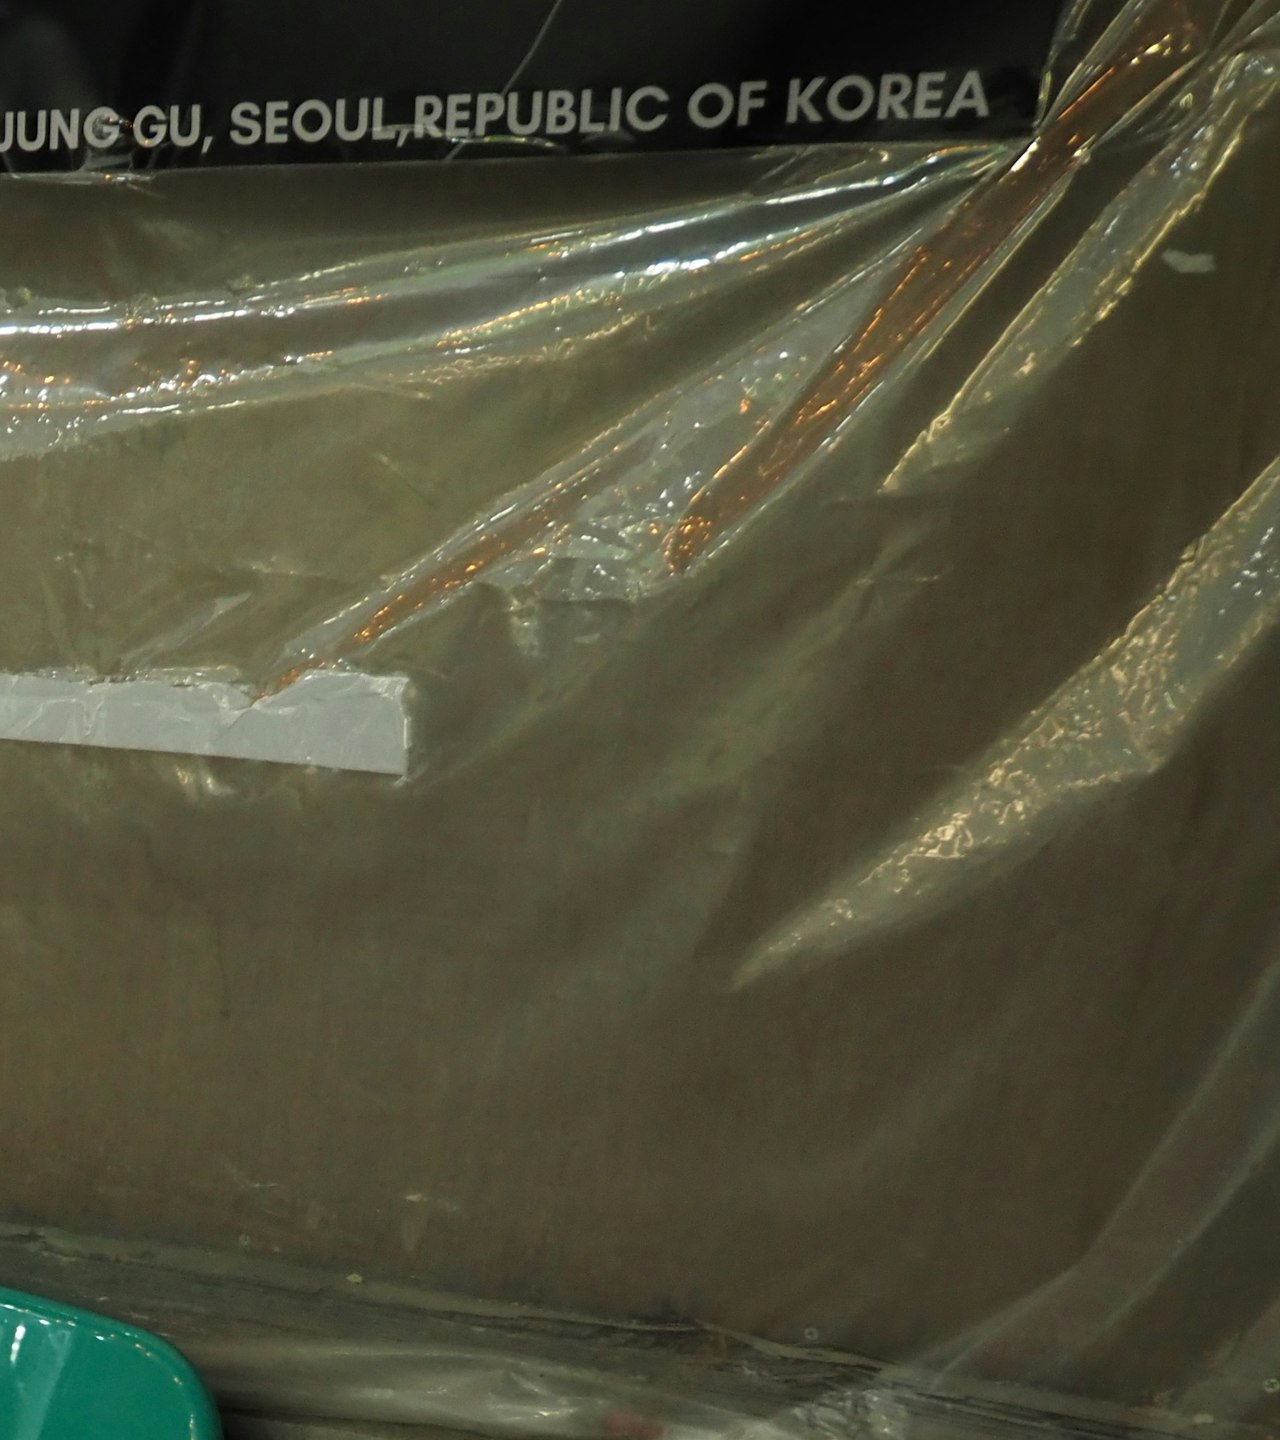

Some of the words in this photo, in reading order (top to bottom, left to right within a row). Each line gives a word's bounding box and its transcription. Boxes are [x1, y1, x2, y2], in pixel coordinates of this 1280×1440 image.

[133, 104, 214, 155] GU,
[687, 81, 768, 130] OF
[785, 70, 990, 124] KOREA
